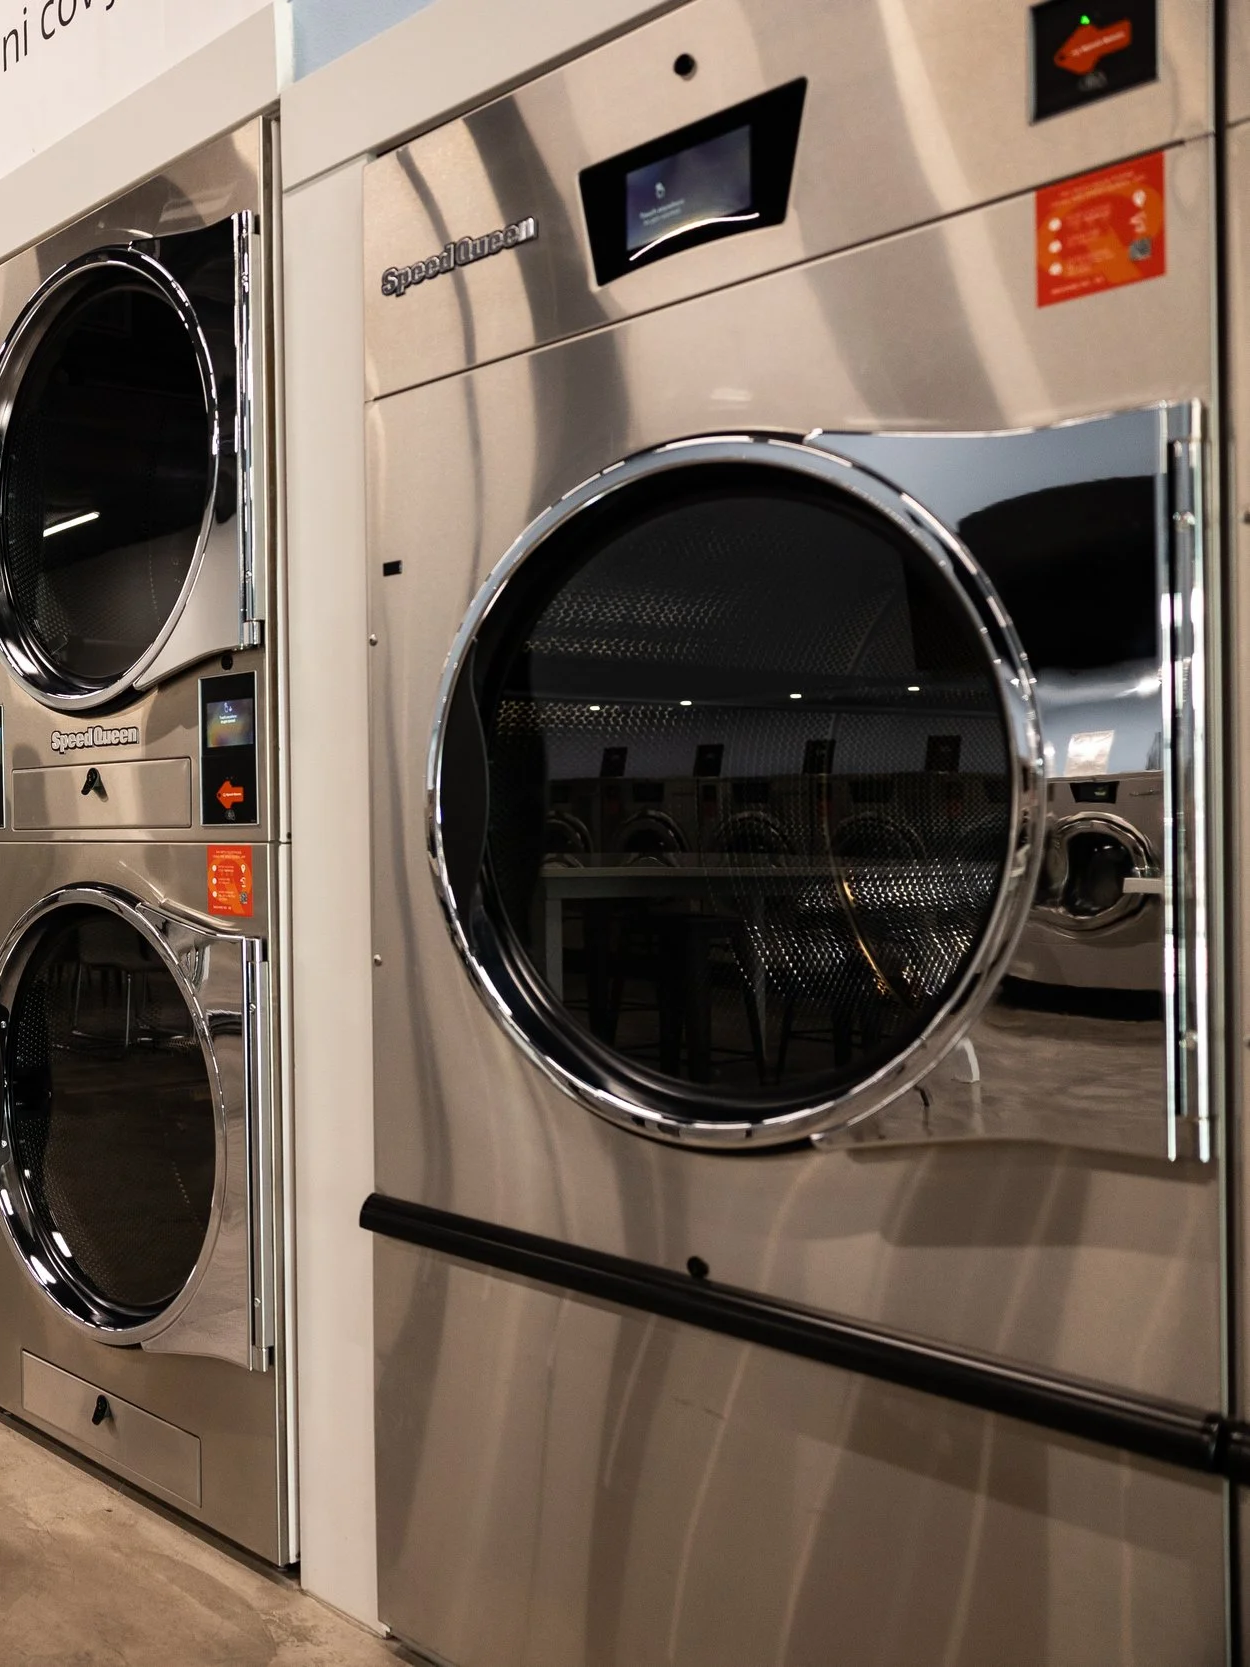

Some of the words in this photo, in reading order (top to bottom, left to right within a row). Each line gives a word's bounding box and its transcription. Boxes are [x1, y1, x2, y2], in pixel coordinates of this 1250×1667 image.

[2, 6, 29, 73] ni
[382, 241, 456, 297] Speed
[454, 216, 539, 266] Queen
[51, 726, 93, 754] Speed
[93, 725, 139, 747] Queen
